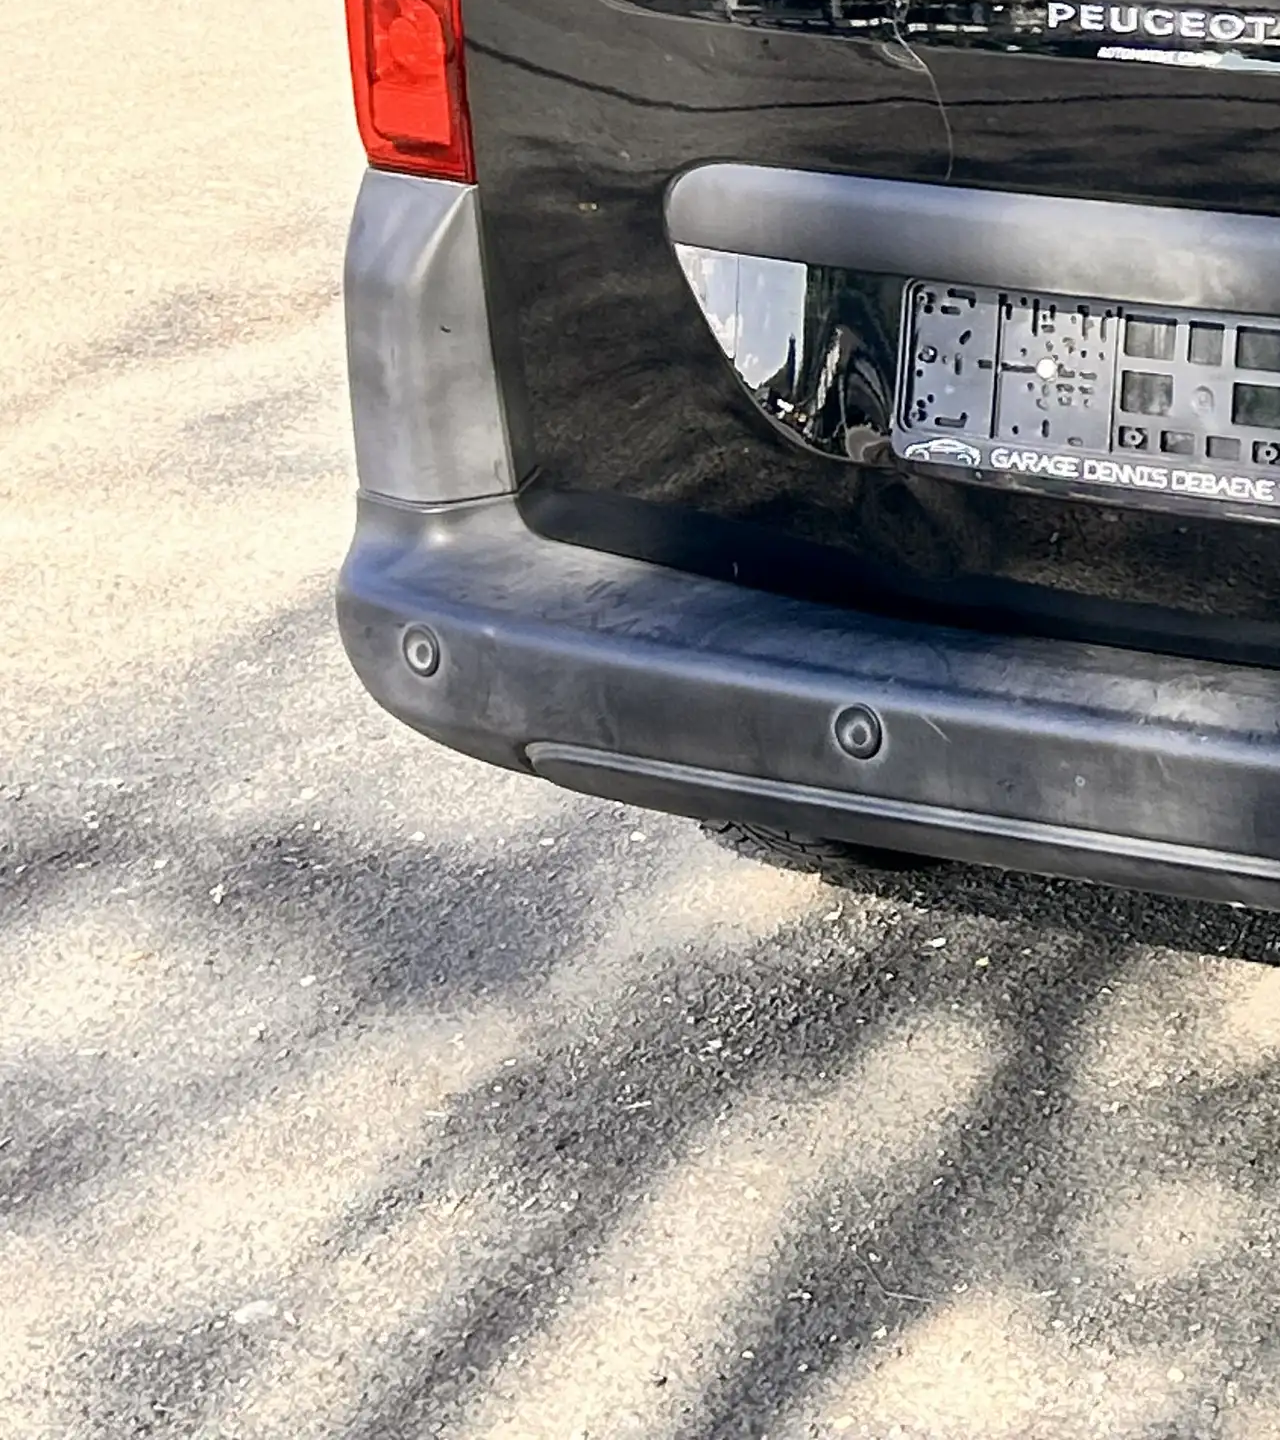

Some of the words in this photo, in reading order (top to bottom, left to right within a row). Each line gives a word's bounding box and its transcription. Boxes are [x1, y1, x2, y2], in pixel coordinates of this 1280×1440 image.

[1047, 2, 1276, 42] PEUGEOT
[990, 448, 1080, 478] GARAGE
[1083, 459, 1168, 489] DENNIS
[1171, 469, 1275, 502] DEBAENE
